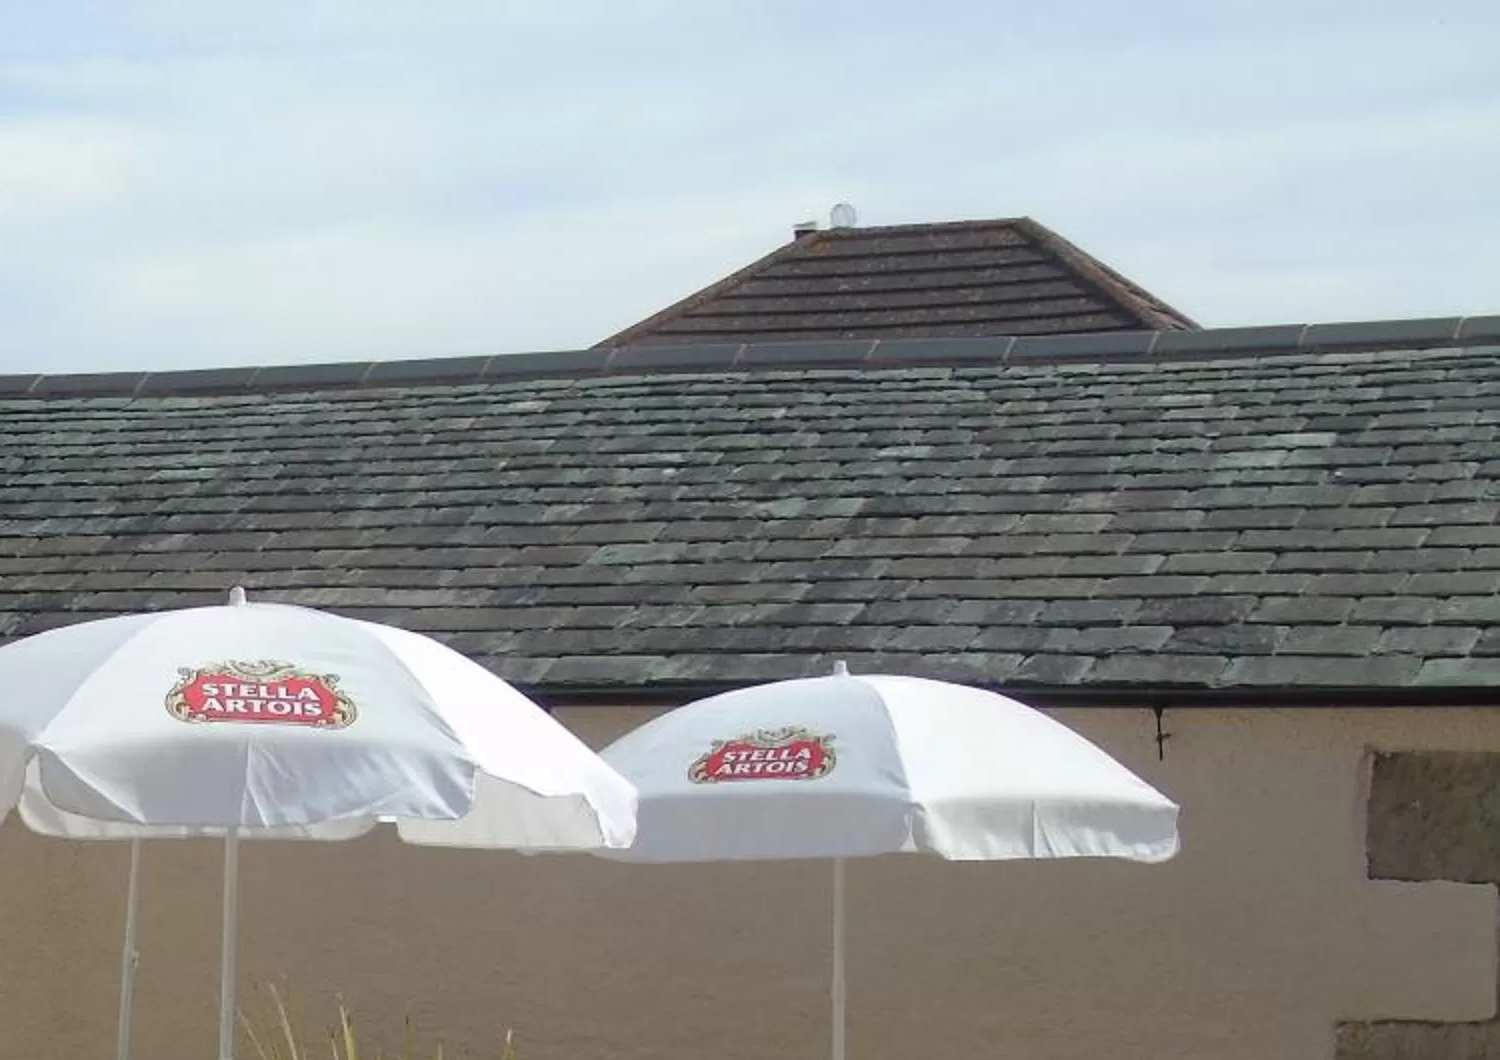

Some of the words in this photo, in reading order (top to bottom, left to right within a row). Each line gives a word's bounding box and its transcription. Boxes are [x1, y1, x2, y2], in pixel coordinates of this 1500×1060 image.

[202, 684, 318, 700] STELLA
[201, 698, 322, 715] ARTOIS
[723, 748, 811, 761] STELLA
[715, 761, 808, 774] ARTOIS
